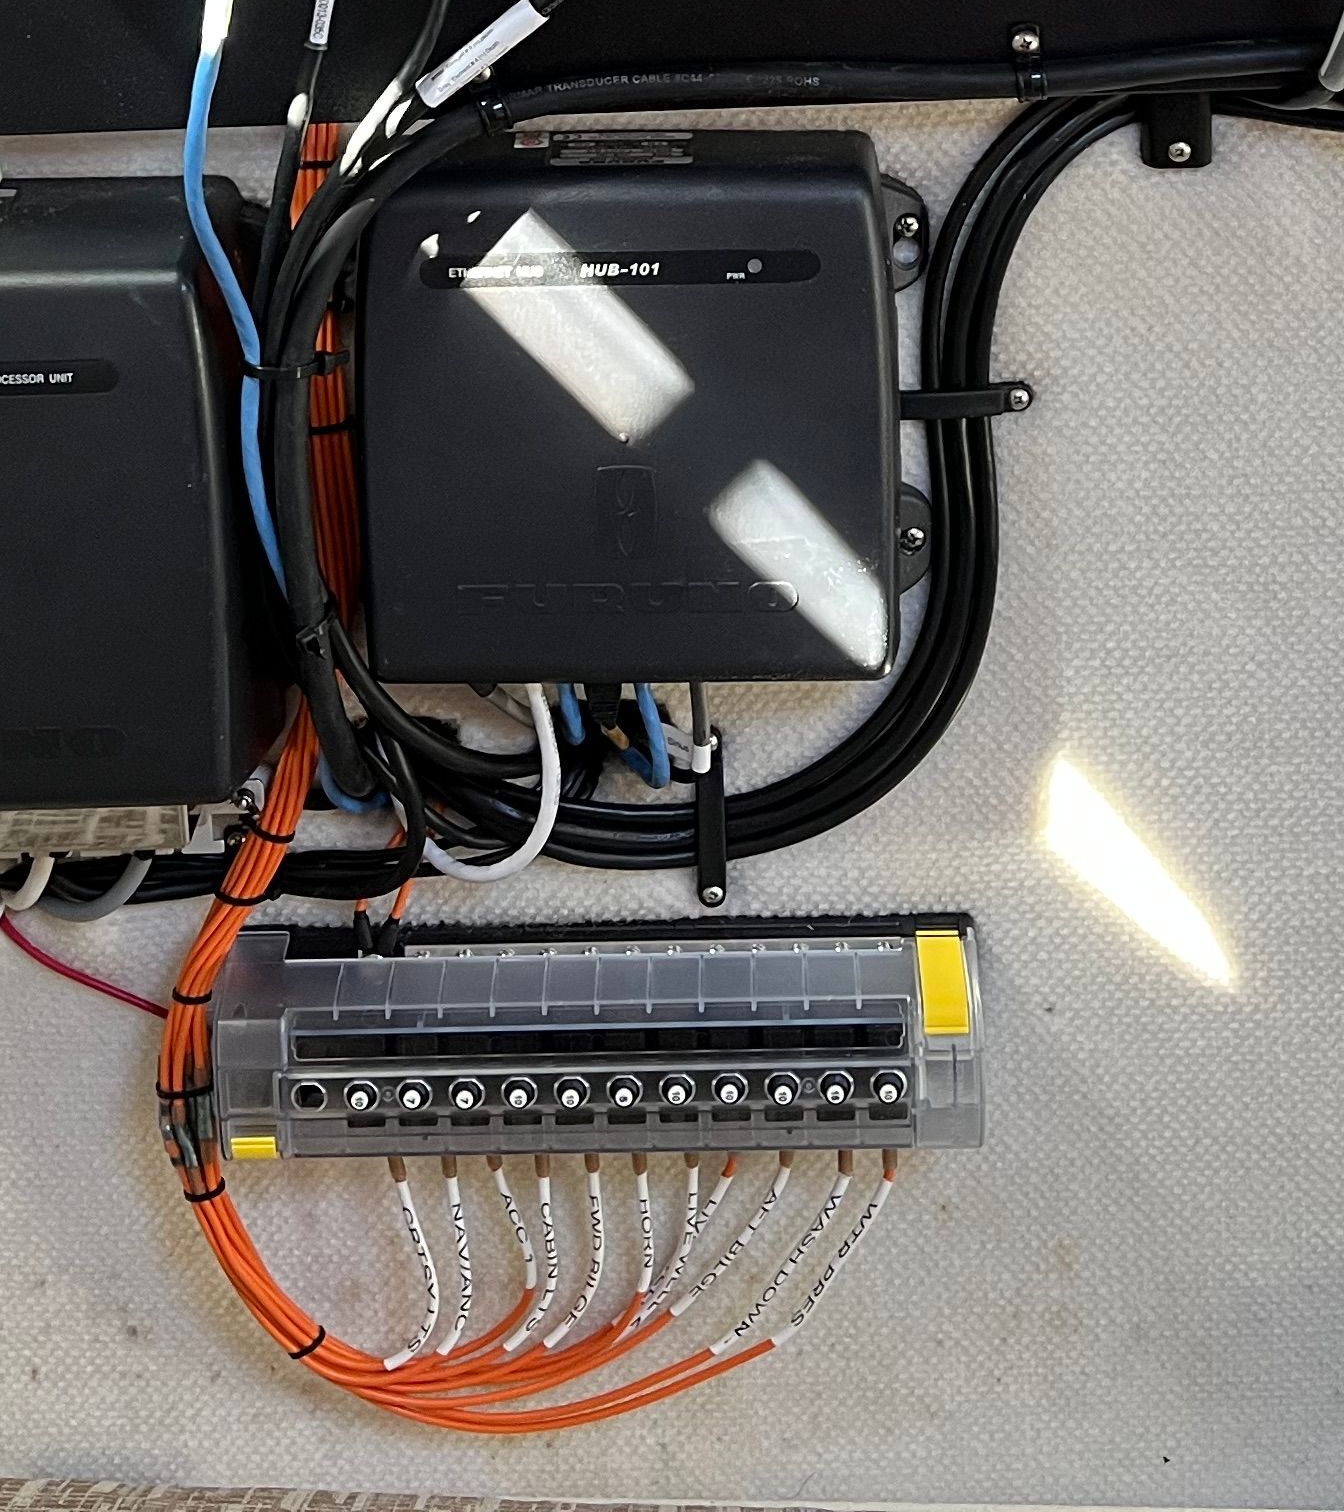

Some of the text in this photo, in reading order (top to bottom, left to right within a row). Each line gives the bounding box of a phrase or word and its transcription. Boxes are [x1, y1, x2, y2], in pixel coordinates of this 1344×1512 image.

[546, 75, 629, 93] TRANSDUCER
[632, 72, 671, 85] CABLE
[580, 263, 660, 279] HUB-101
[49, 372, 74, 385] UNIT
[500, 1192, 529, 1245] ACC
[540, 1202, 558, 1279] CABIN
[588, 1194, 603, 1252] FWD
[638, 1198, 654, 1269] HORN
[734, 1194, 842, 1337] WASH DOWN
[790, 1202, 878, 1327] WTR PRES
